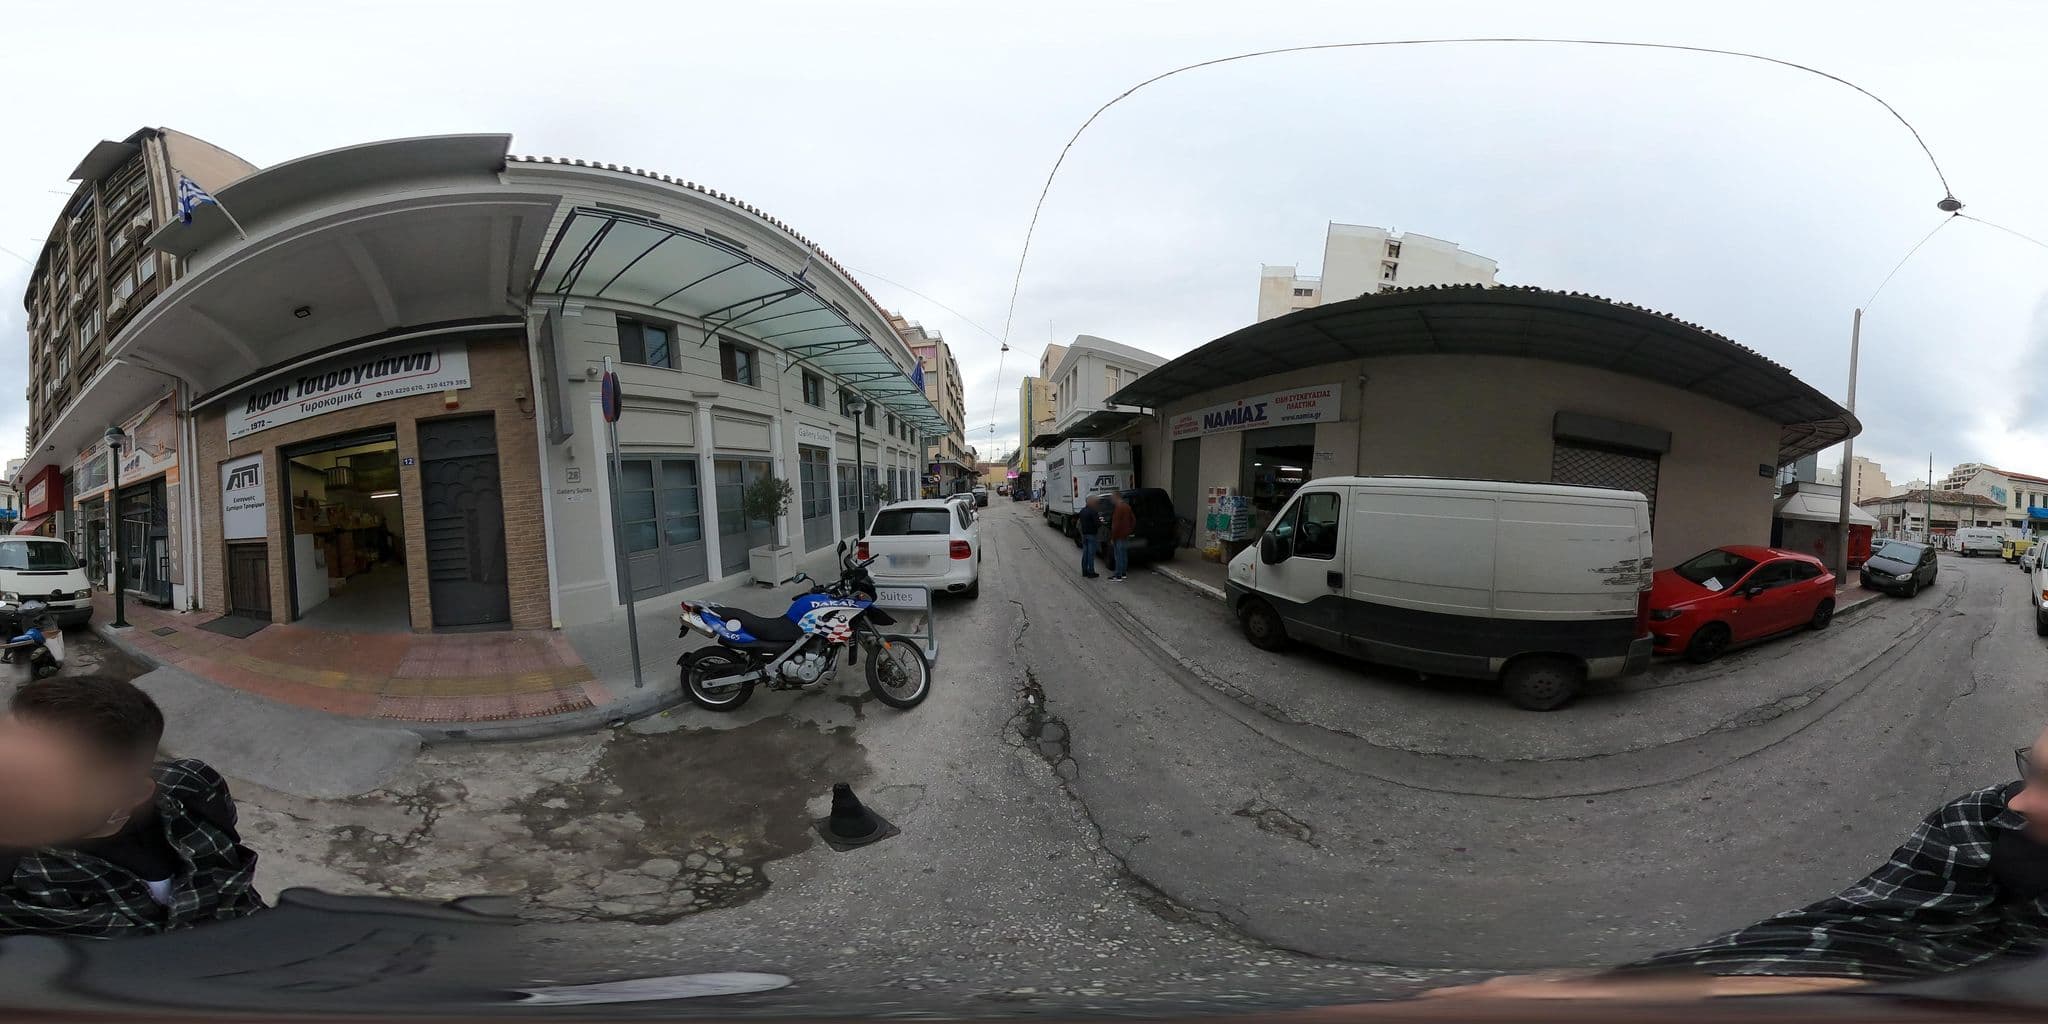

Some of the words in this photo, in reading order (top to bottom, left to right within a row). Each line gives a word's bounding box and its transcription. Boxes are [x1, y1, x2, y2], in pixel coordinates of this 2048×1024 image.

[296, 351, 434, 398] Τσιρογιάννη
[299, 388, 362, 413] Τυροκομικά
[250, 420, 265, 430] 1972
[880, 591, 913, 601] Suites
[810, 599, 859, 608] DAKAR
